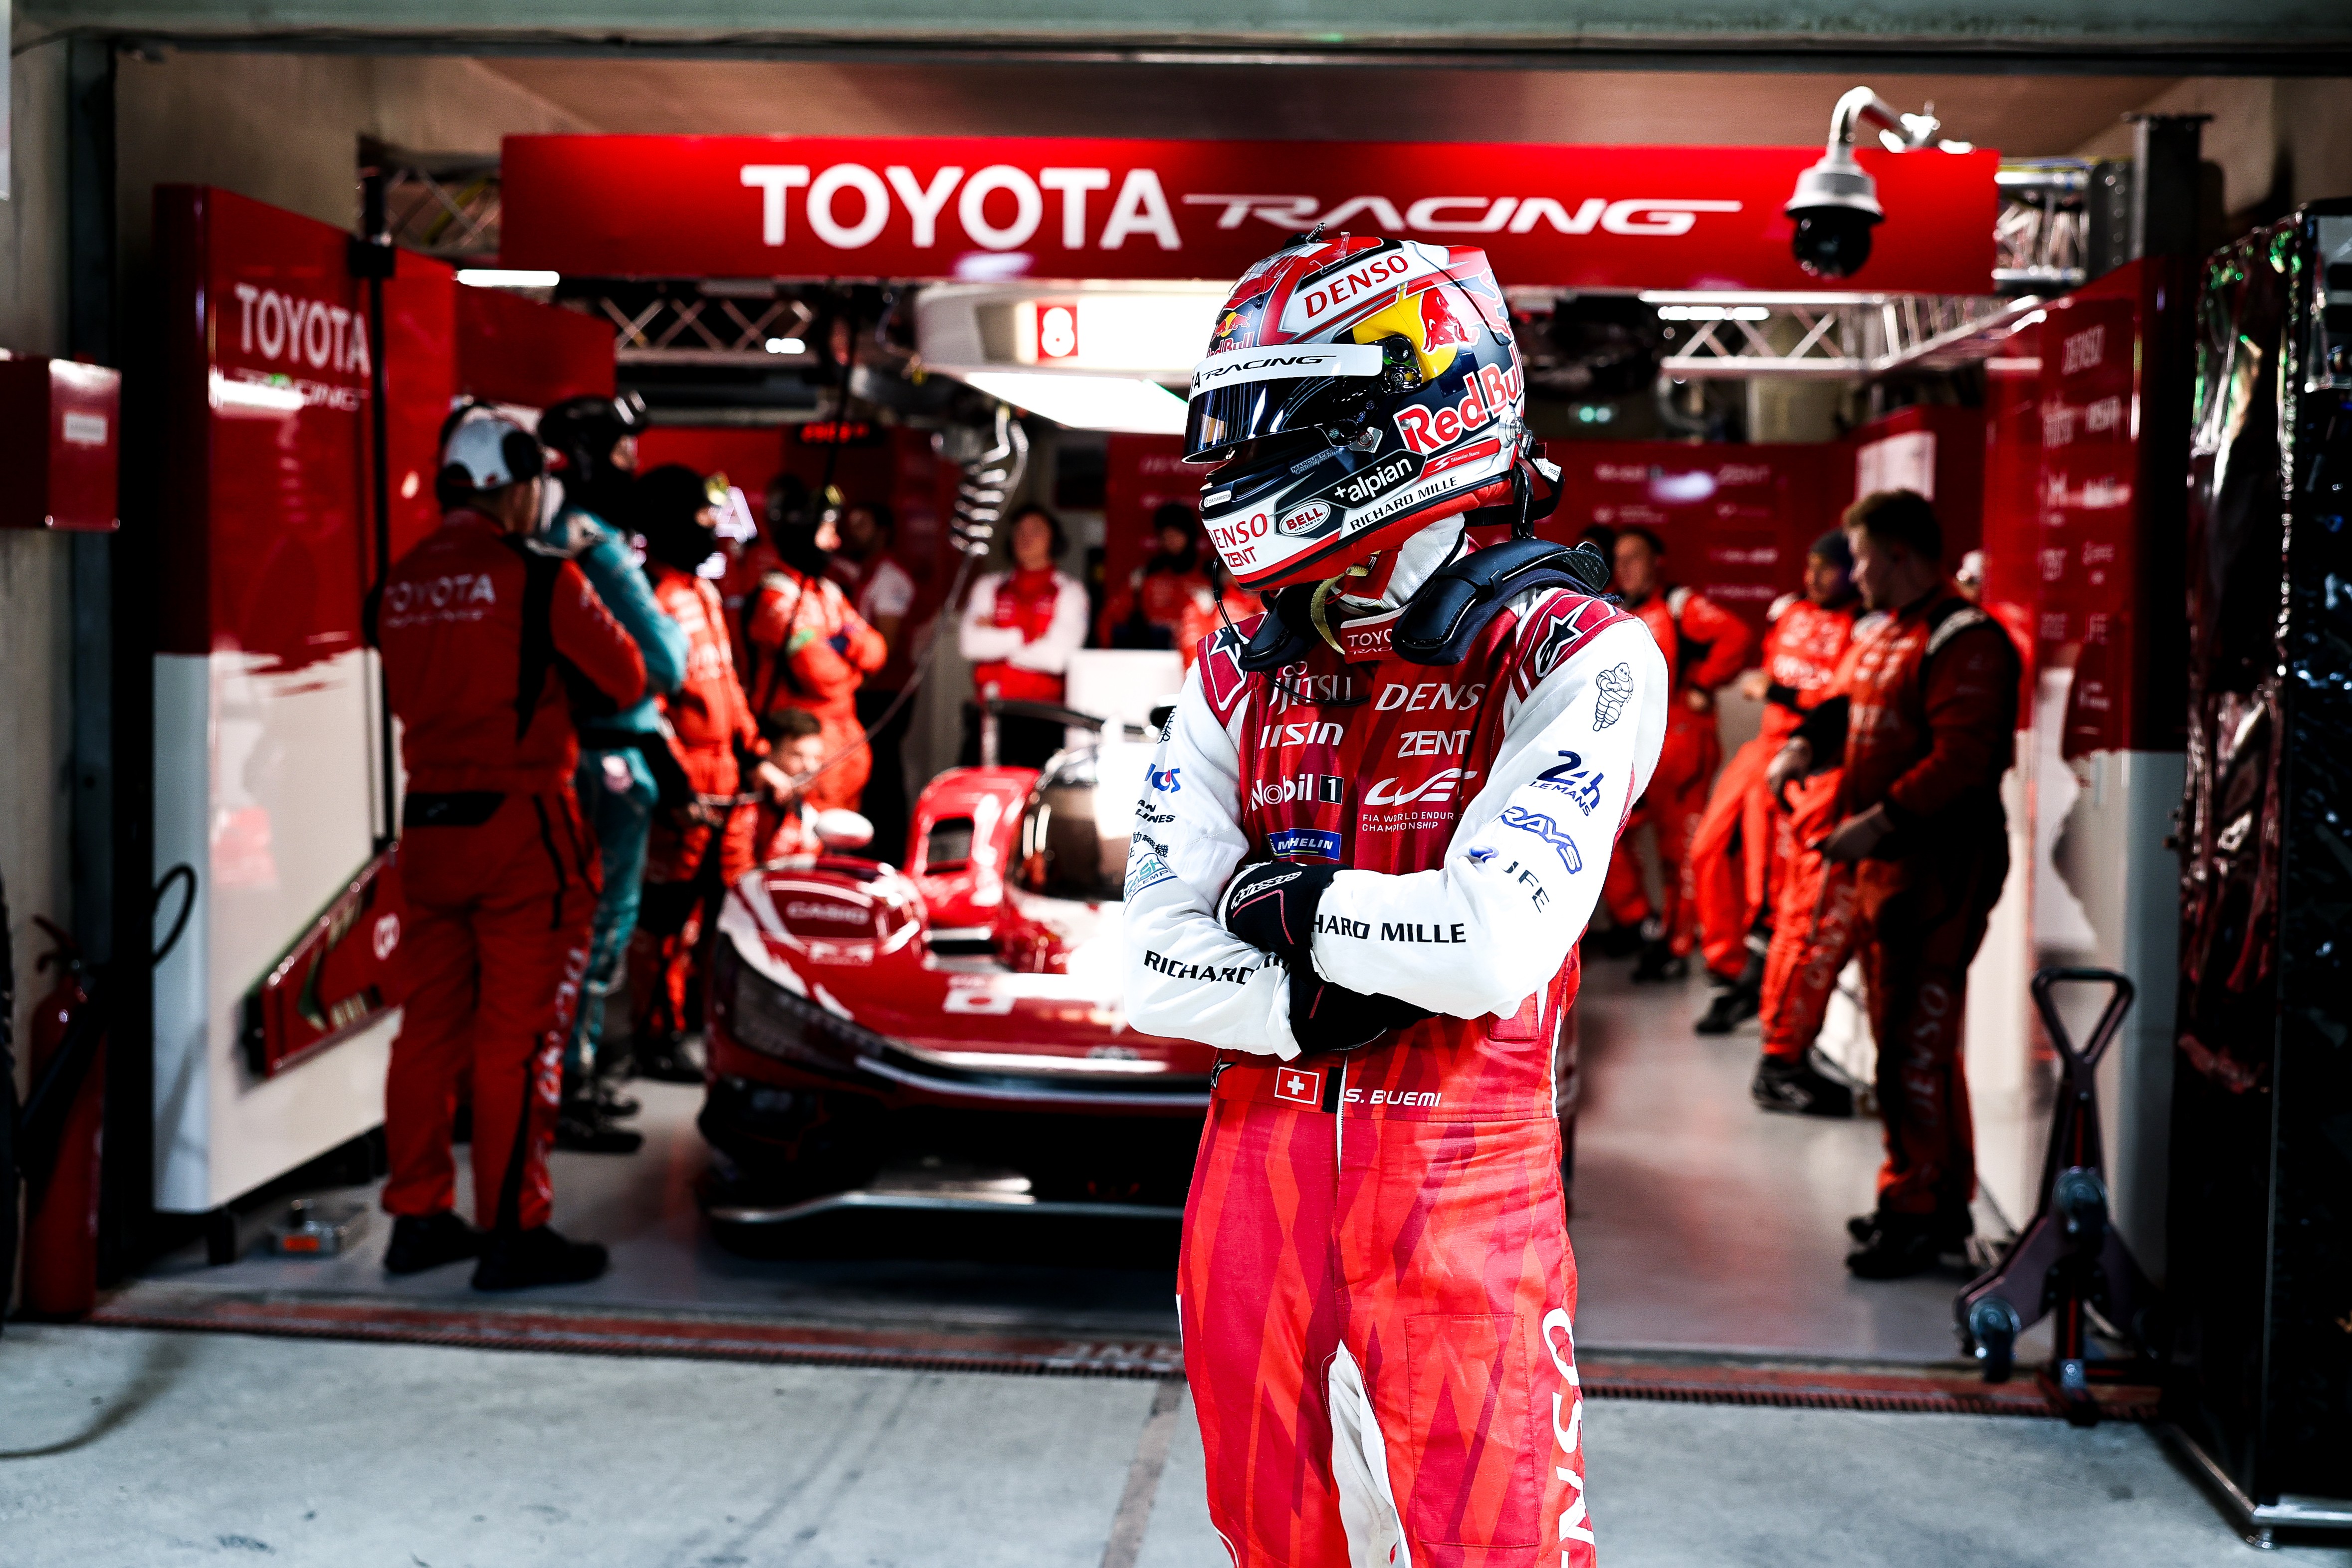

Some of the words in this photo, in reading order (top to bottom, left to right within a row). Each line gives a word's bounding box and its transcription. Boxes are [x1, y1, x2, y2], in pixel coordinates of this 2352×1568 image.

[740, 163, 1182, 250] TOYOTA
[1183, 195, 1742, 236] RACING
[1304, 255, 1408, 318] DENSO
[234, 283, 370, 377] TOYOTA
[1041, 307, 1075, 357] 8
[1202, 355, 1337, 380] RACING
[1394, 373, 1489, 455] Red
[1291, 455, 1319, 472] MARCUS
[1548, 467, 1559, 476] 2022
[1350, 494, 1413, 530] RICHARD
[1418, 476, 1458, 499] MILLE
[1285, 508, 1323, 530] BELL
[1295, 518, 1320, 532] HELMETS
[1224, 546, 1257, 567] ZENT
[1347, 629, 1392, 647] TOYO
[1374, 683, 1487, 712] DENS
[1398, 729, 1471, 759] ZENT
[1529, 781, 1552, 790] LE
[1551, 784, 1591, 817] MANS
[1362, 821, 1438, 832] CHAMPIONSHIP
[1363, 814, 1380, 822] FIA
[1383, 812, 1418, 823] WORLD
[1278, 838, 1333, 850] MHELIN
[1314, 914, 1370, 940] HARD
[1381, 922, 1466, 943] MILLE
[1144, 949, 1256, 985] RICHARD
[1343, 1088, 1365, 1104] S.
[1369, 1089, 1442, 1107] BUEMI
[1542, 1308, 1595, 1568] NSO
